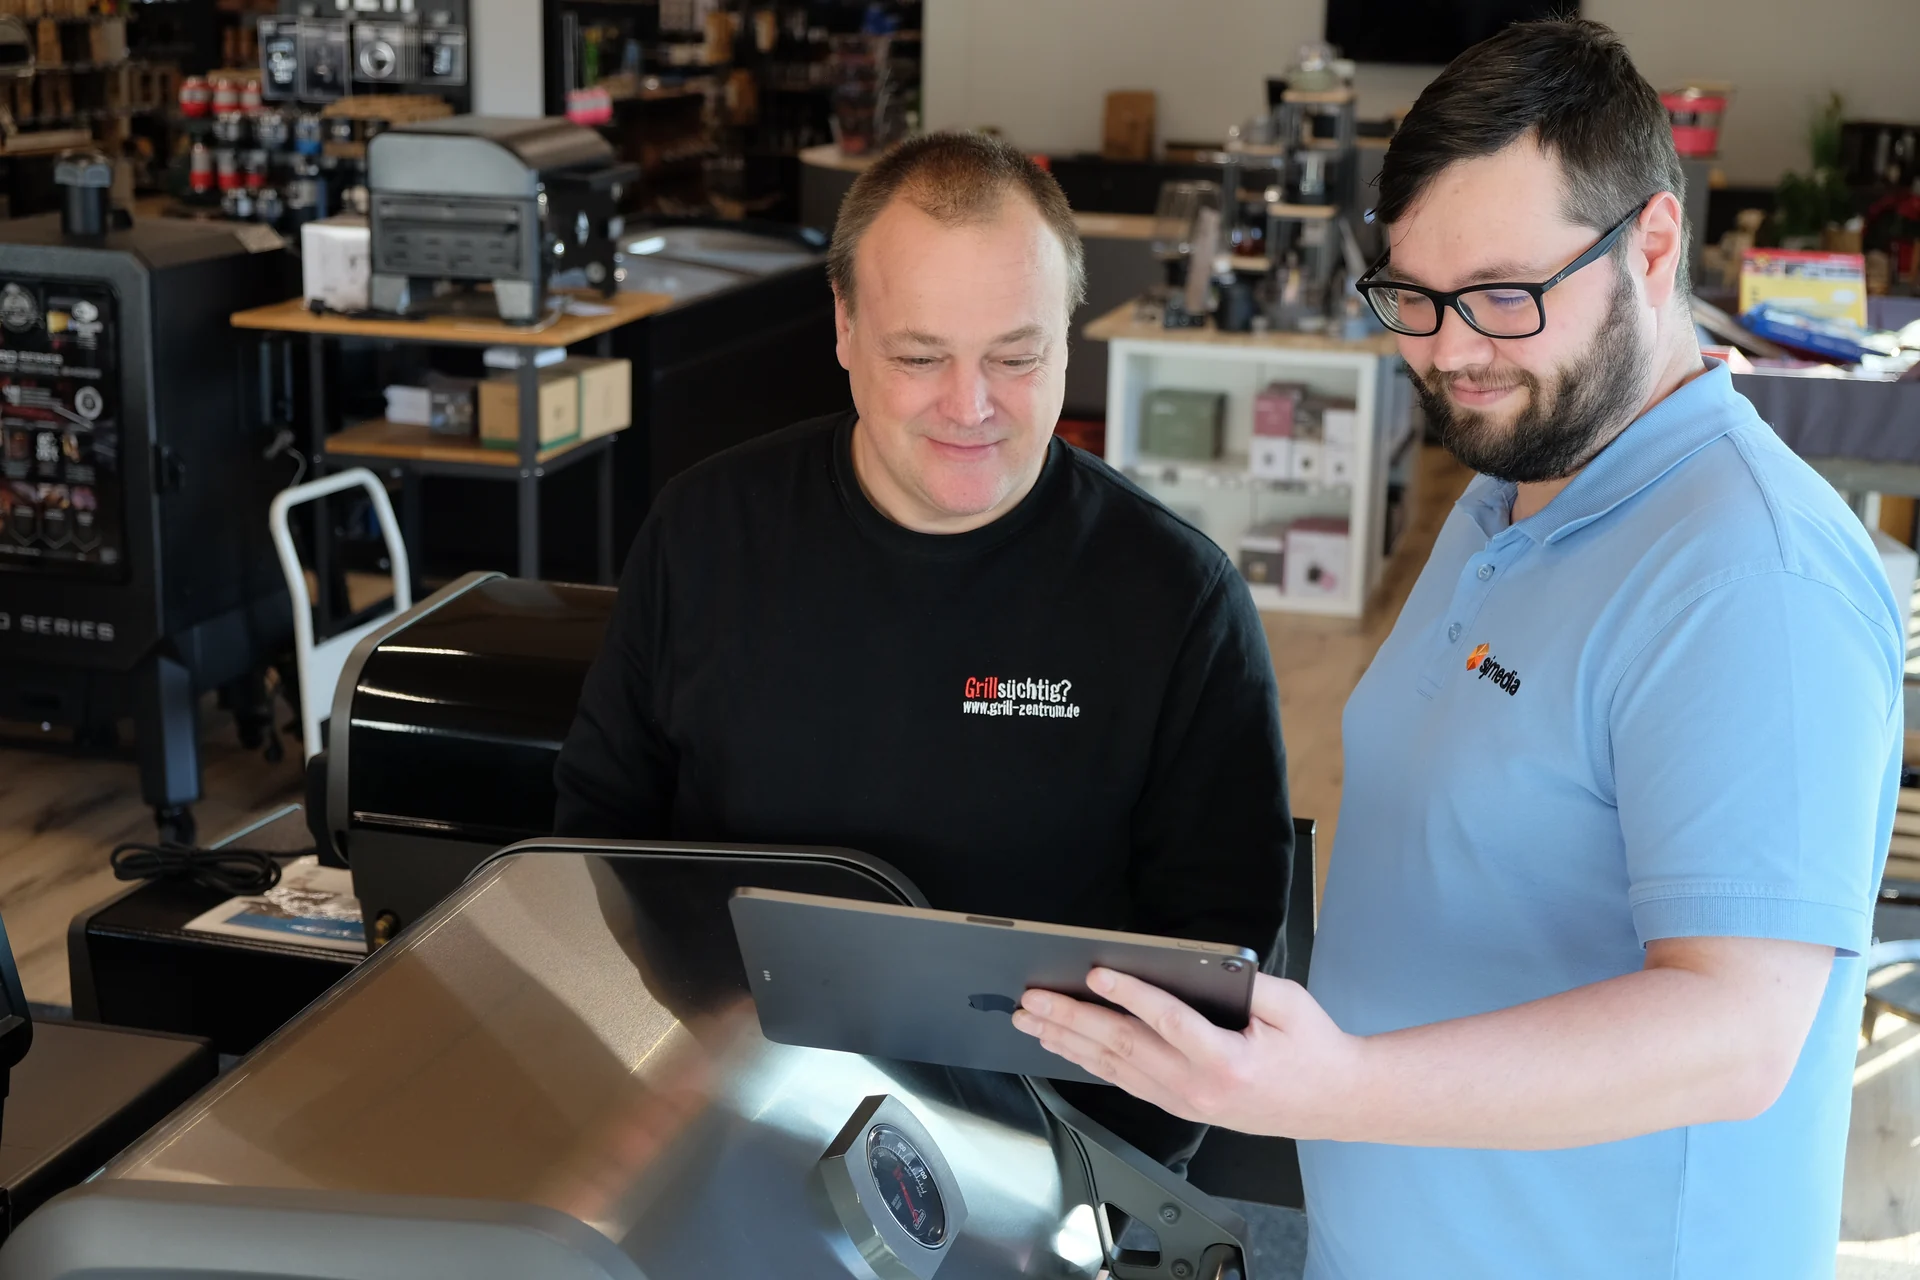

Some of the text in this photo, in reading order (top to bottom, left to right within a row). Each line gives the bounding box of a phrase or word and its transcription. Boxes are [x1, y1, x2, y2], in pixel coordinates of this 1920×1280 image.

[20, 614, 115, 642] SERIES
[964, 676, 1072, 703] Grillsüchtig?
[963, 700, 1080, 718] www.grill-zentrum.de
[918, 1167, 928, 1180] 700
